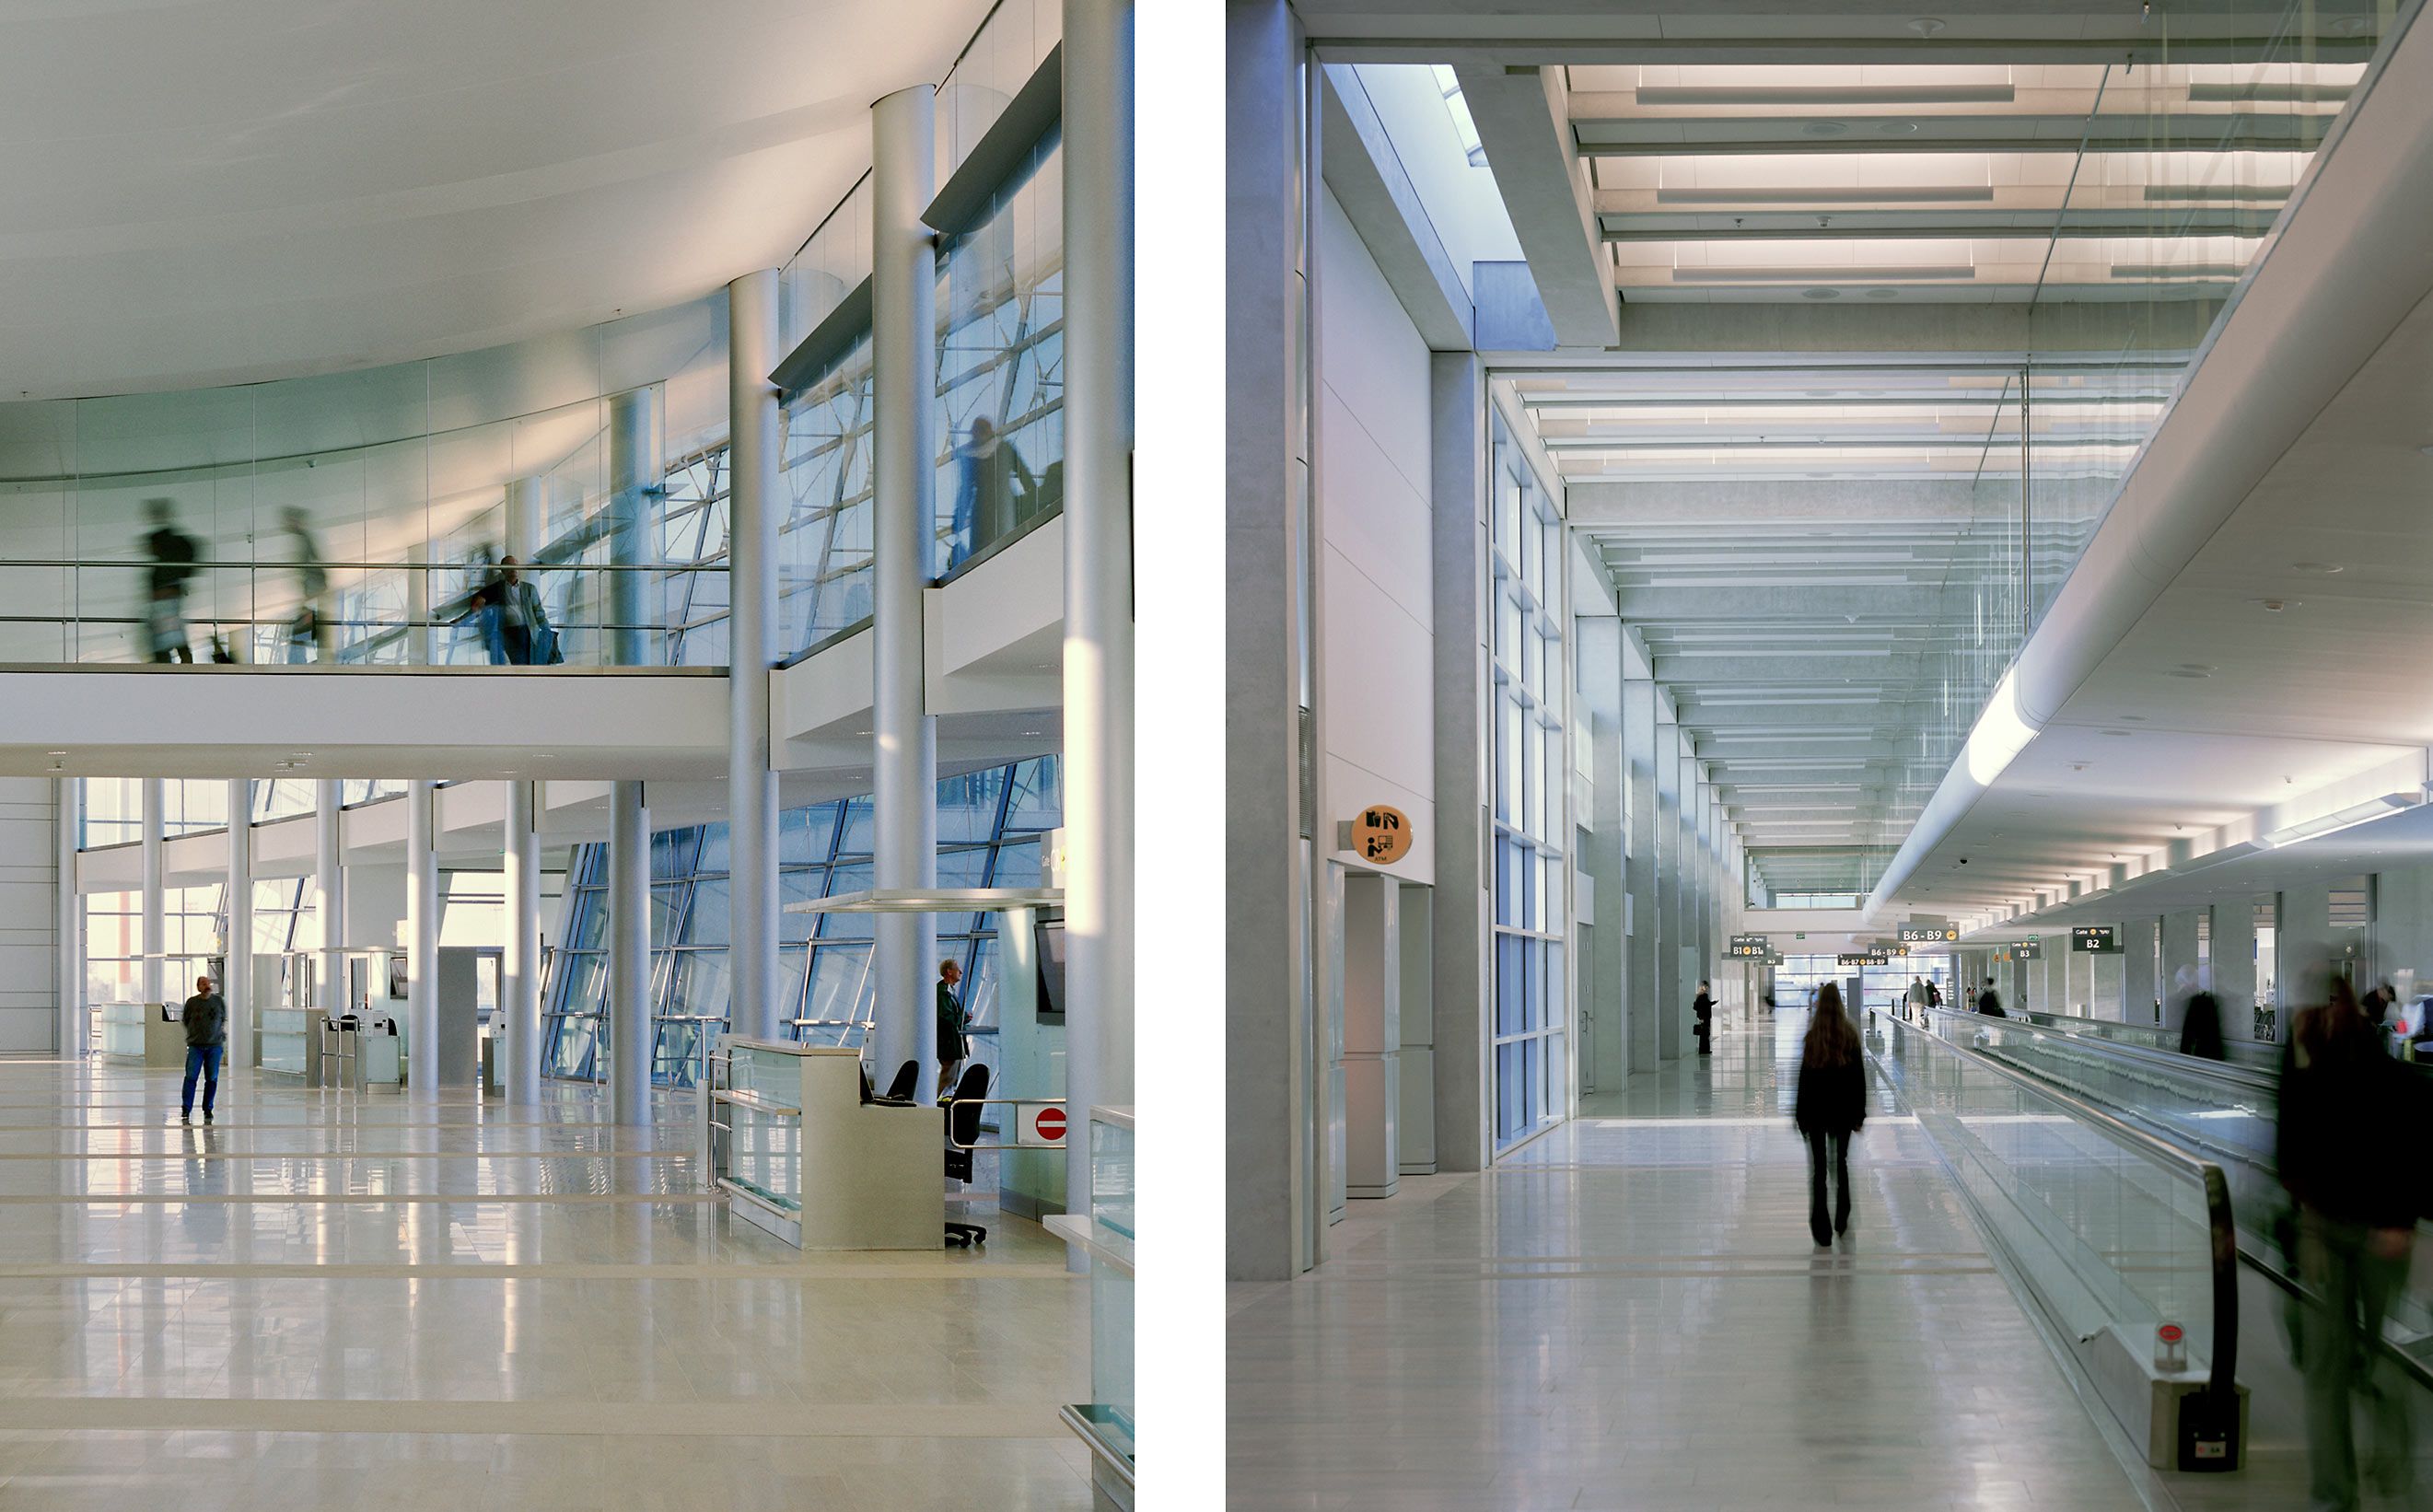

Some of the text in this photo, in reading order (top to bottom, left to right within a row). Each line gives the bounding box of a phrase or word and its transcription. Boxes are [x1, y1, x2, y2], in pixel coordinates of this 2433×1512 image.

[1903, 930, 1918, 940] B6
[1927, 930, 1942, 940] B9
[2086, 939, 2100, 948] B2
[1733, 947, 1742, 955] B1
[2020, 949, 2031, 958] B3
